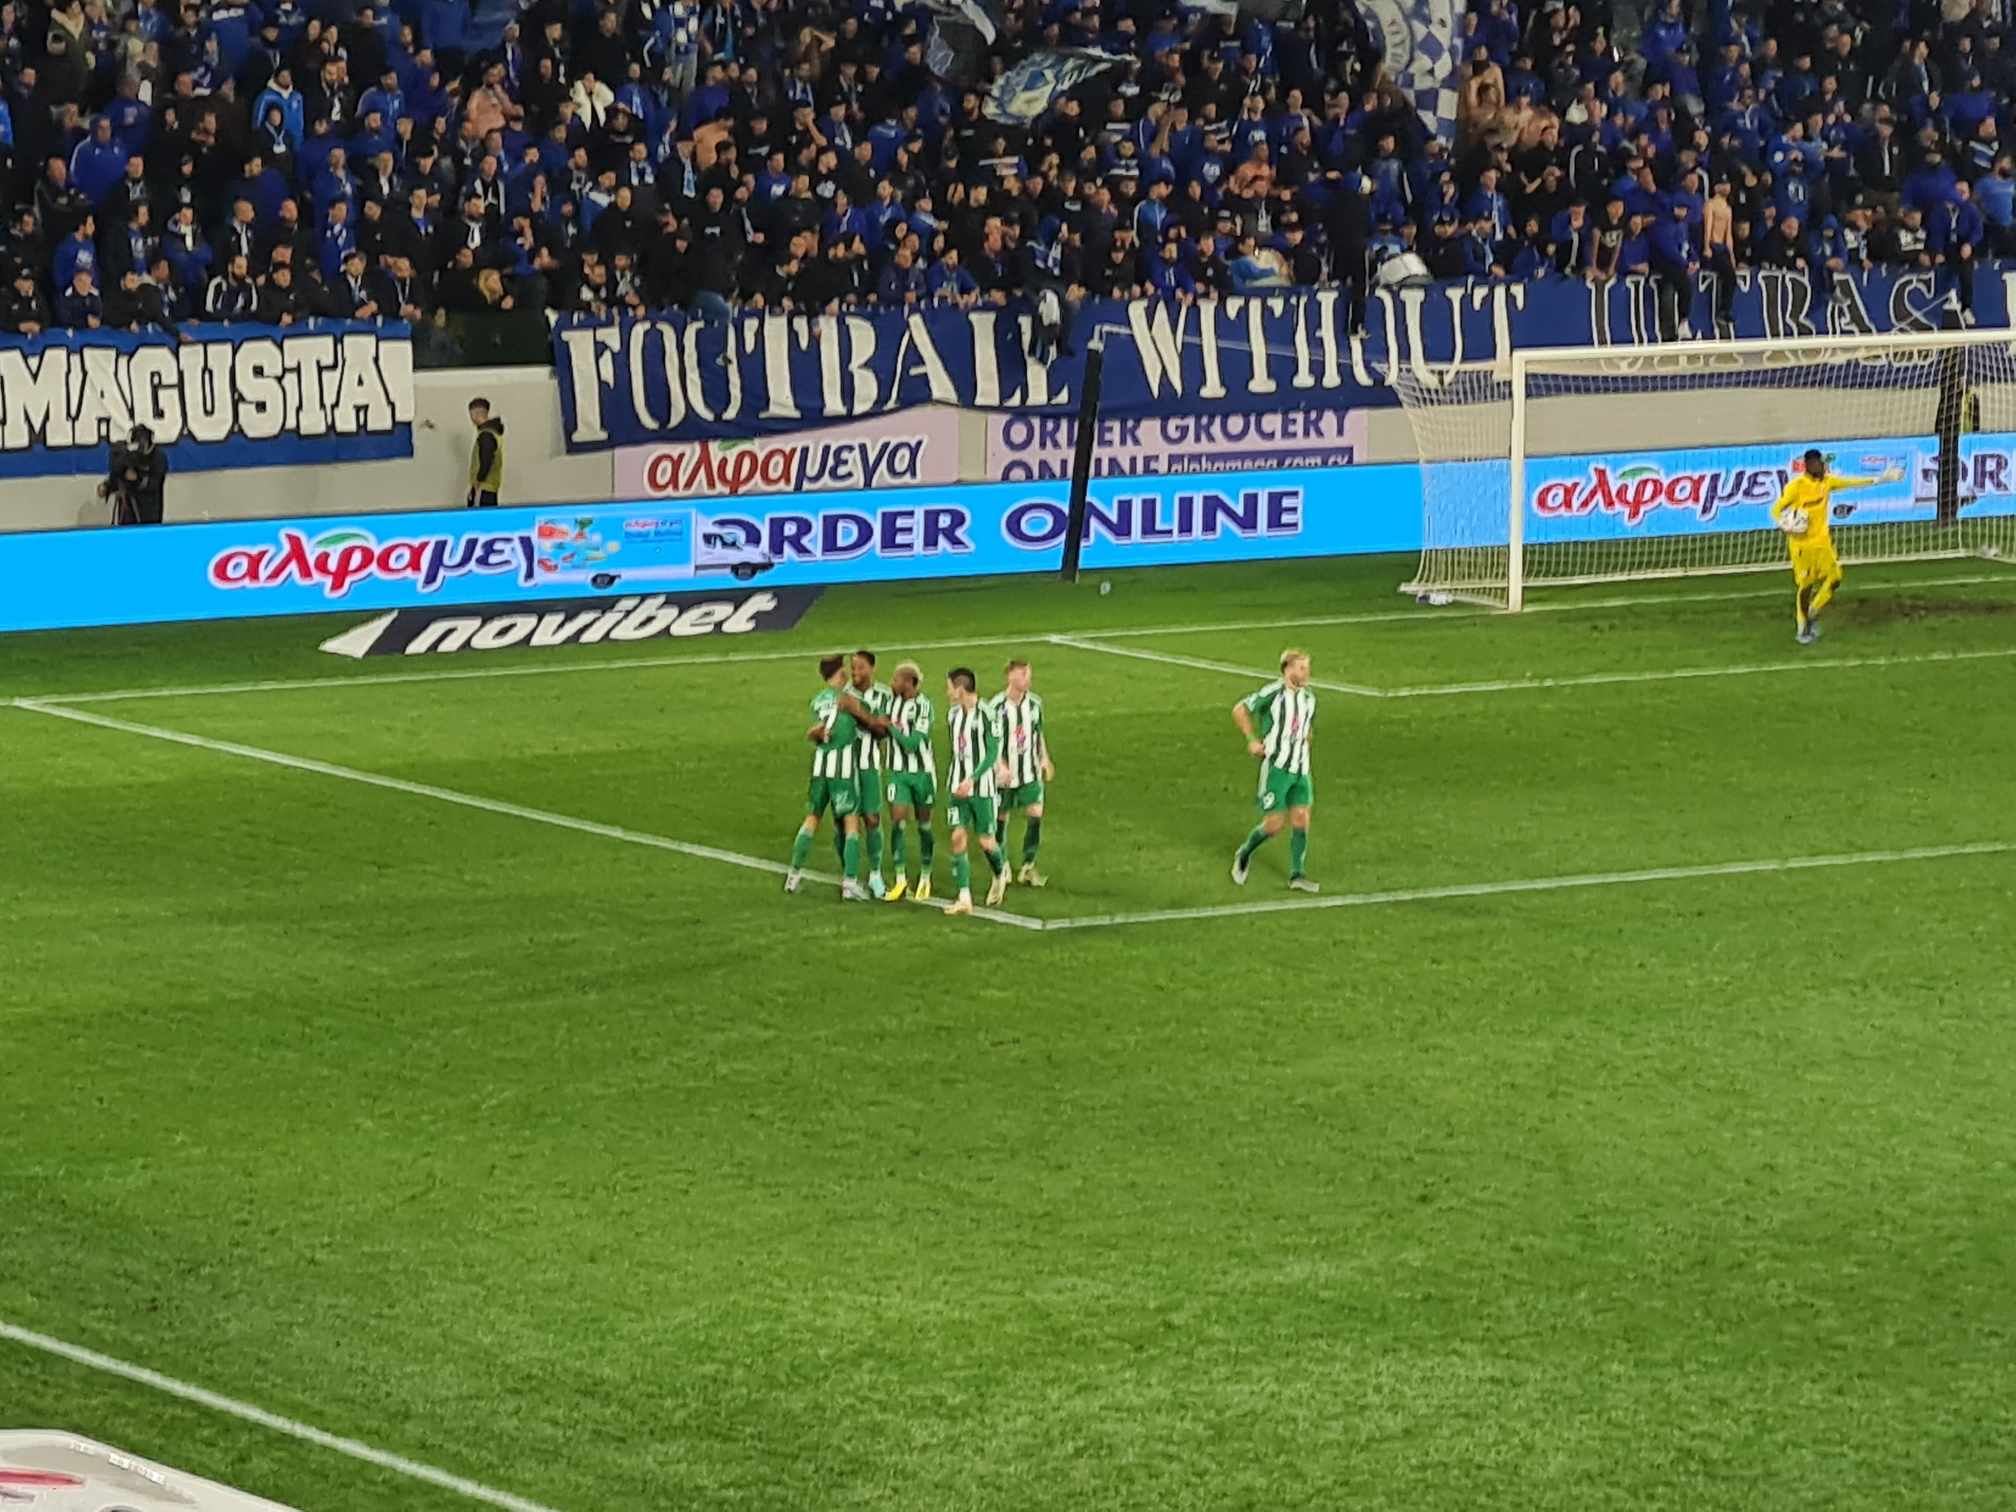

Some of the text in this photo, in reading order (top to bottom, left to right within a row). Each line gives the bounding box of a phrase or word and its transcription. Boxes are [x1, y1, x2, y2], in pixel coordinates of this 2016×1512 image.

[0, 334, 394, 449] MAGUSTA
[561, 309, 1069, 443] FOOTBALL
[1128, 284, 1525, 399] WITHOUT
[1160, 408, 1350, 445] GROCERY
[646, 440, 923, 495] αλφαμεγα
[1001, 456, 1160, 482] ONINE
[1004, 490, 1300, 548] ONLINE
[404, 593, 778, 655] novibet
